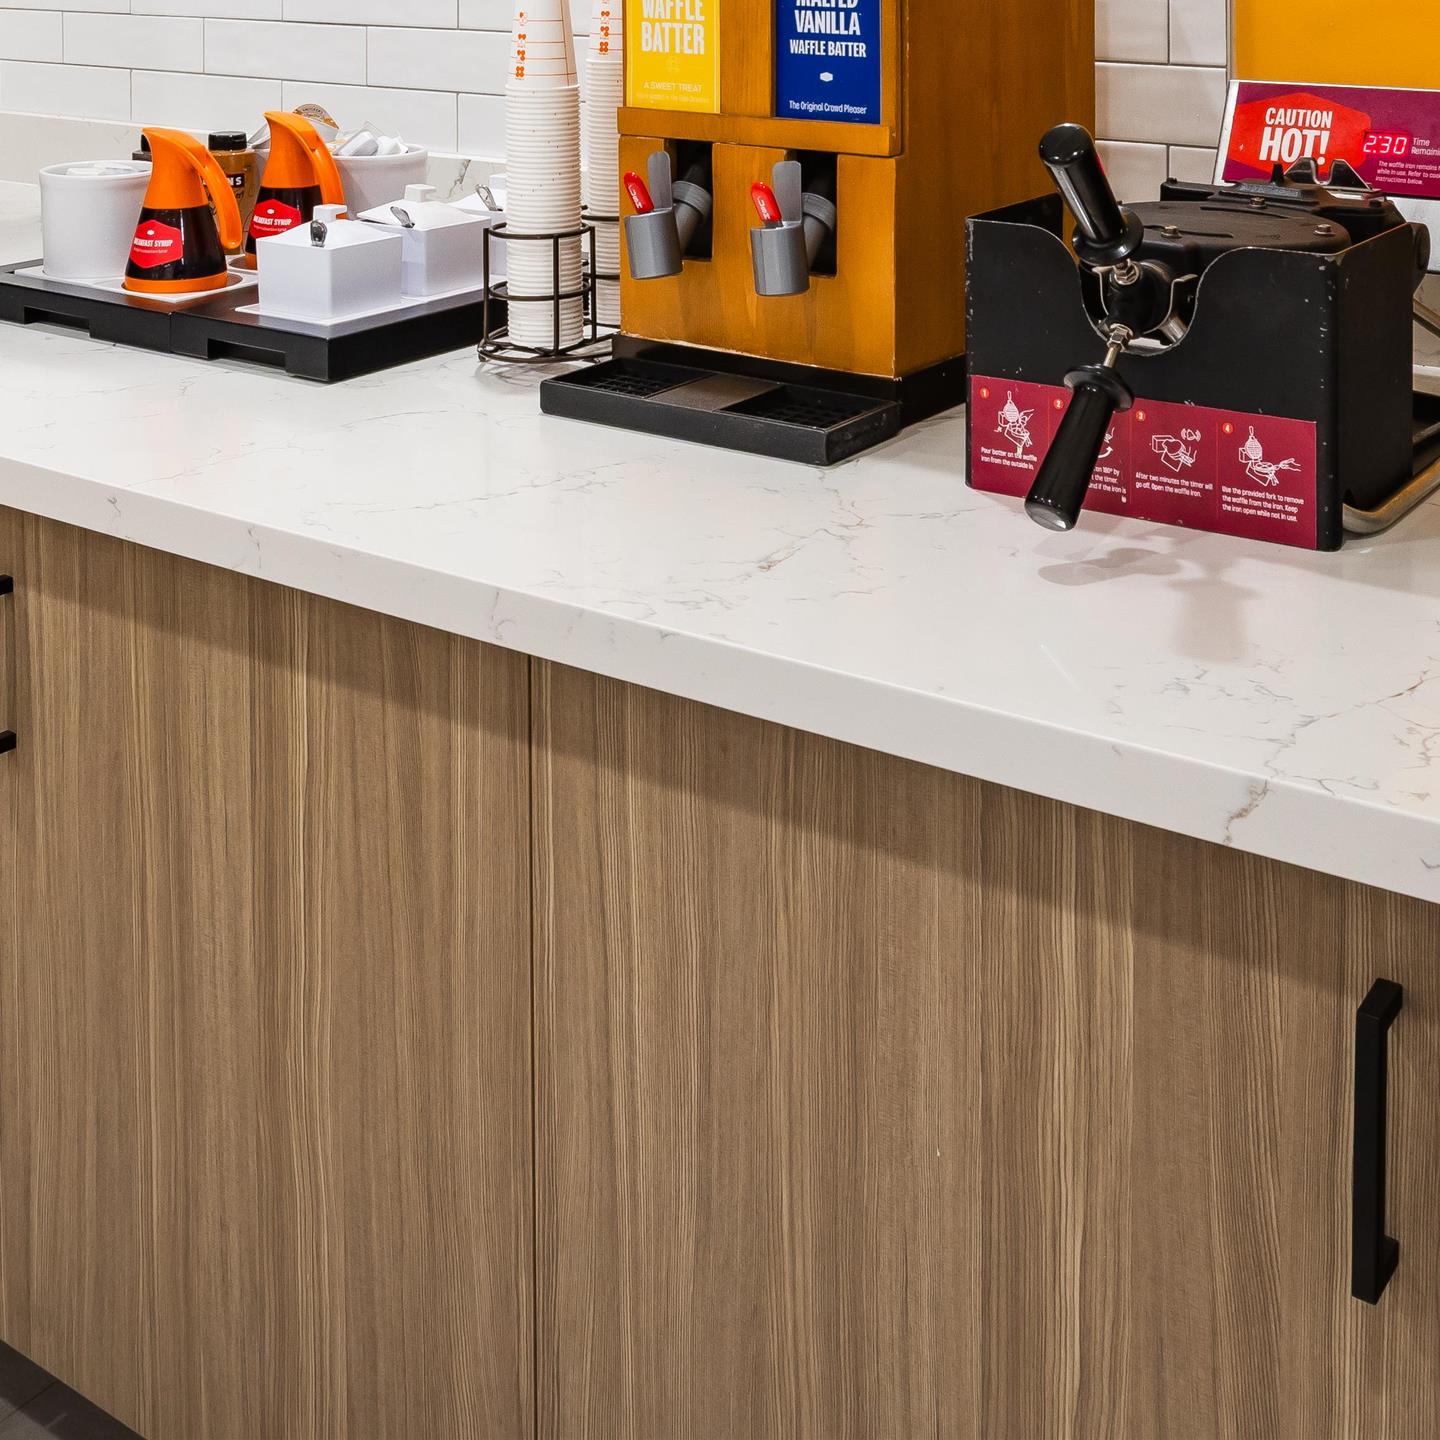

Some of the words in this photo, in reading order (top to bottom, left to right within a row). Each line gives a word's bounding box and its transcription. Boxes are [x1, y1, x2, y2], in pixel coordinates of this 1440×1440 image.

[794, 9, 861, 35] VANILLA
[641, 21, 705, 55] BATTER
[789, 39, 826, 56] WAFFLE
[828, 41, 867, 58] BATTER
[650, 81, 676, 91] SWEET
[678, 83, 703, 92] TREAT
[788, 100, 800, 109] The
[800, 101, 824, 113] Original
[824, 102, 843, 113] Crowd
[844, 104, 867, 114] Pleaser
[1265, 107, 1333, 129] CAUTION
[1259, 127, 1331, 165] HOT!
[1363, 135, 1407, 155] 2:30
[1413, 137, 1430, 147] Time
